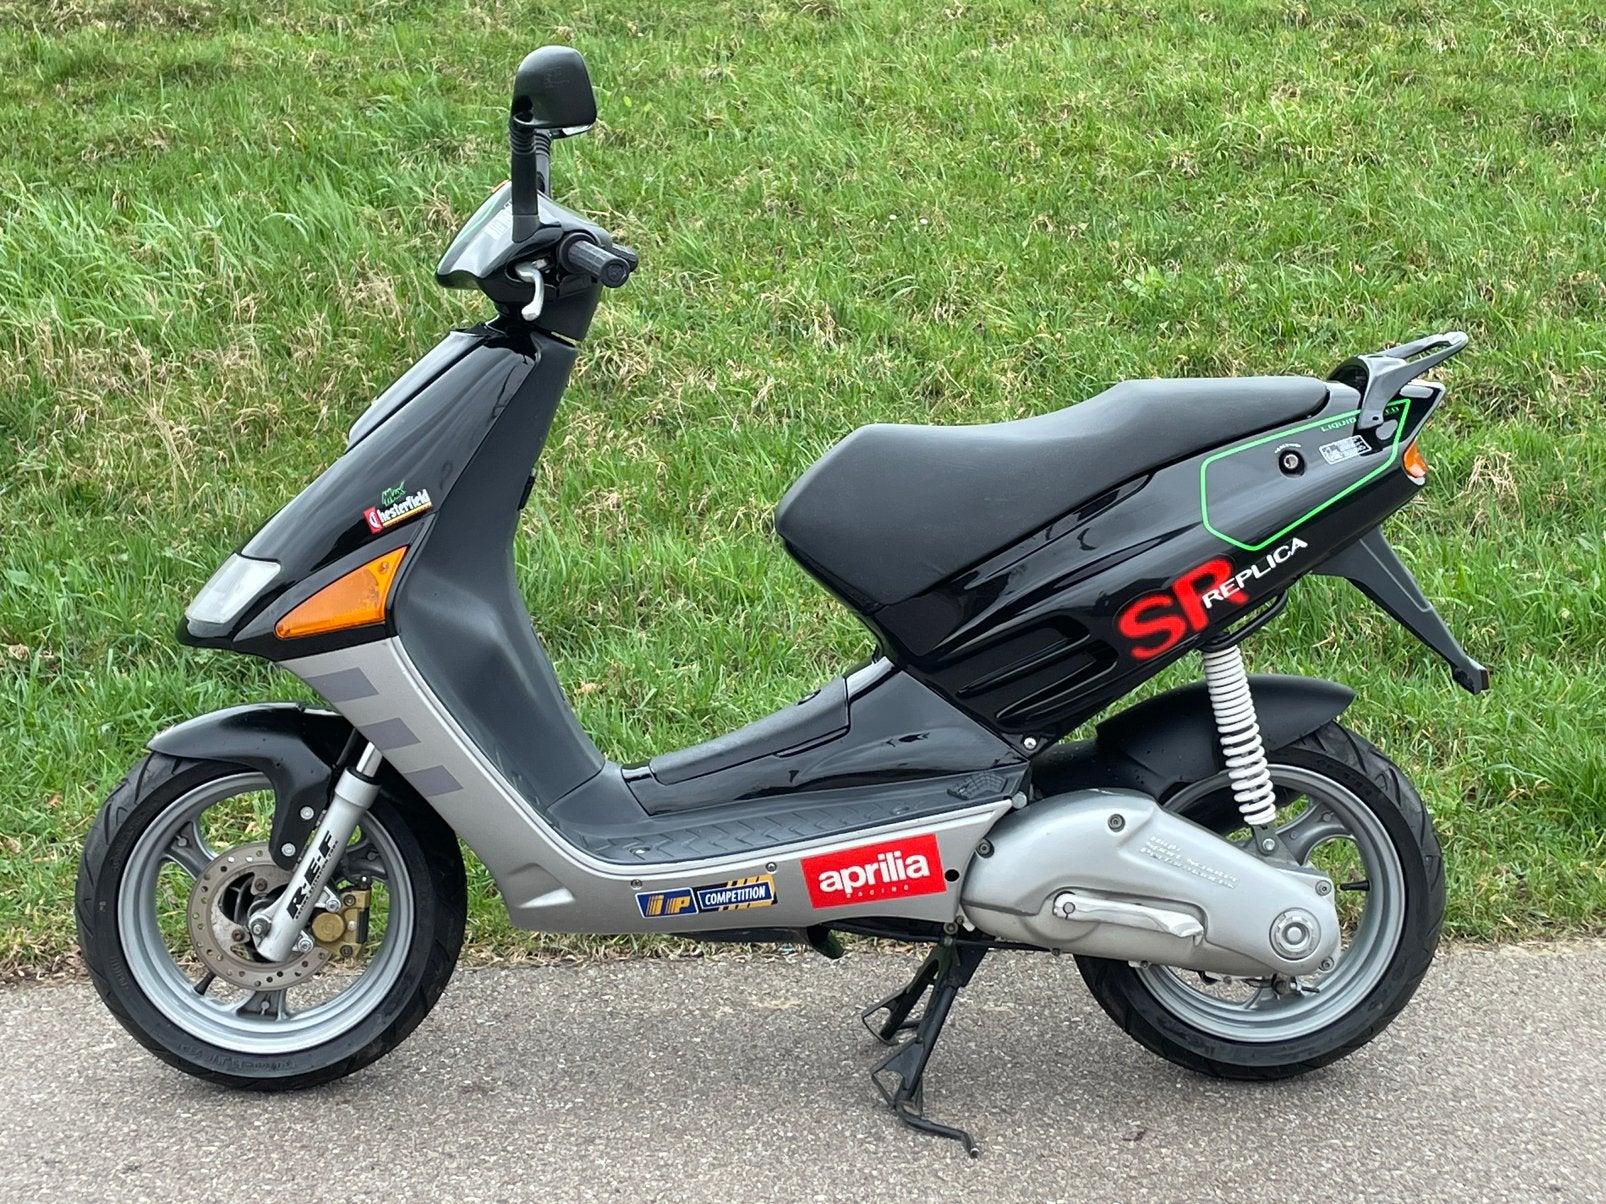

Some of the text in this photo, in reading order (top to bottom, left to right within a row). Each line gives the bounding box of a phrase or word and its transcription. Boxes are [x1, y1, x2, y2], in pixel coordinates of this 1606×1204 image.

[1202, 537, 1308, 609] REPLICA
[1119, 558, 1249, 661] SR
[705, 885, 766, 906] COMPETITION
[818, 851, 930, 894] aprilia
